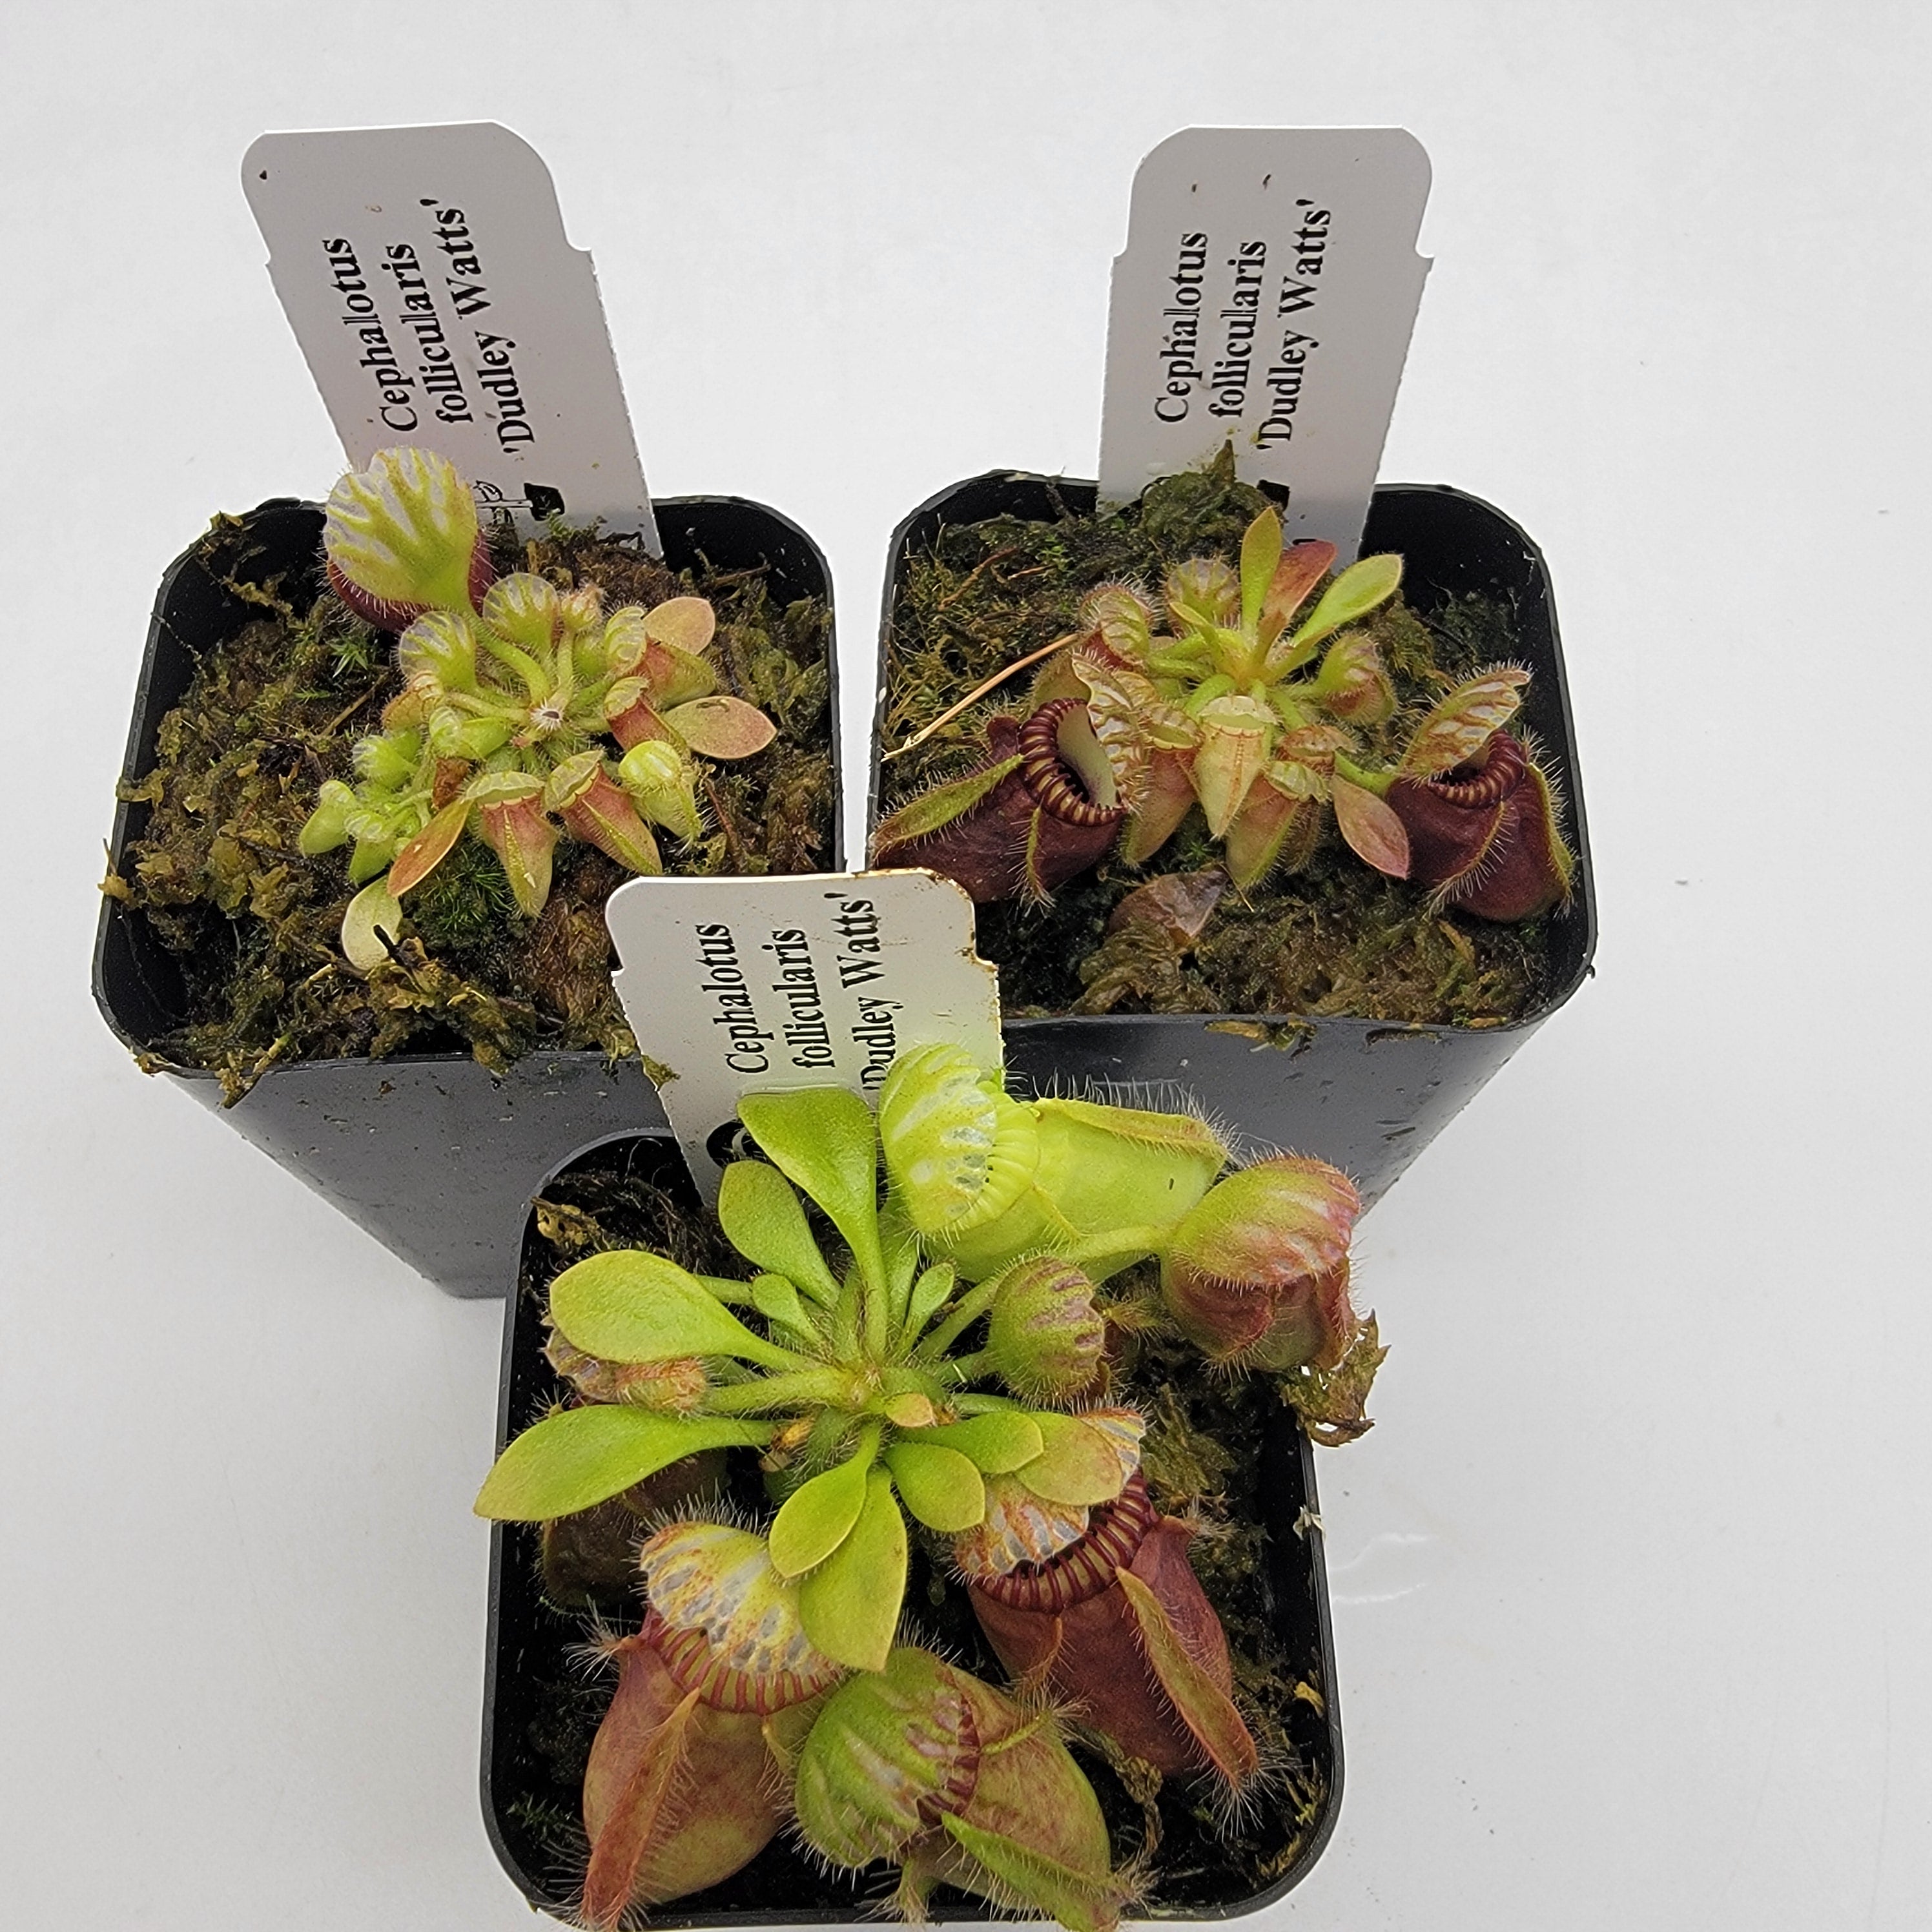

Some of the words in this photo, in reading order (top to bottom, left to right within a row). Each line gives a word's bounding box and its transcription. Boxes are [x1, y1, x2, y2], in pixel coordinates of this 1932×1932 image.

[420, 198, 491, 320] Watts'
[1155, 232, 1208, 423] Cephalotus
[1277, 198, 1331, 318] Watts'
[323, 238, 417, 431] Cephalotus
[382, 243, 473, 423] follicularis
[475, 331, 535, 453] 'Dudley
[1208, 240, 1267, 418] follicularis
[1257, 330, 1319, 450] 'Dudley
[695, 924, 774, 1073] Cephalotus
[762, 929, 836, 1069] follicularis
[823, 892, 886, 989] Watts'
